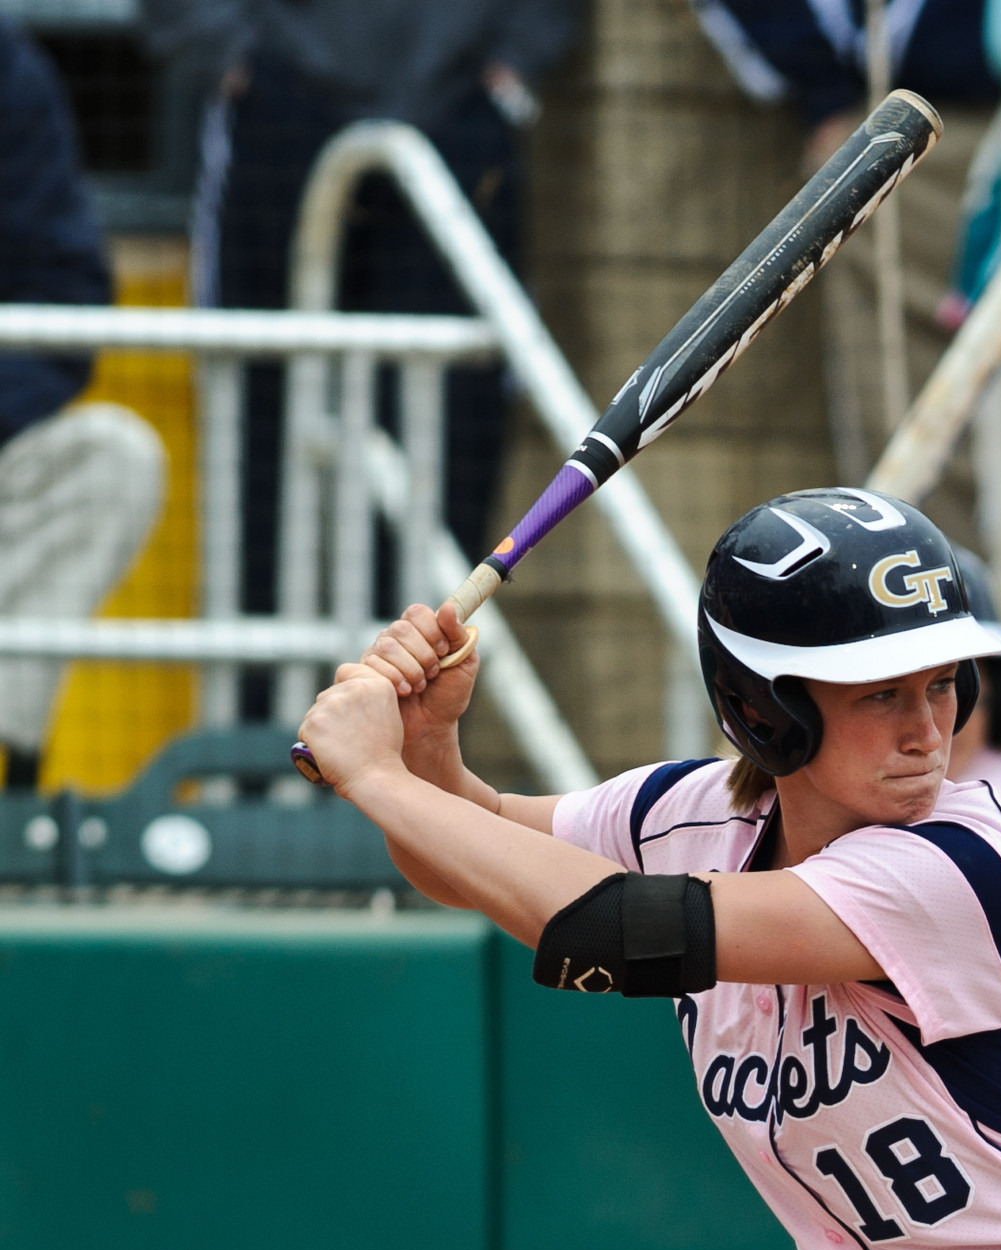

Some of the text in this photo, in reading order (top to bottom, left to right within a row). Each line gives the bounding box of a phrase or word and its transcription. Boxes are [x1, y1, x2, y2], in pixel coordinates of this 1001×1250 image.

[868, 549, 953, 613] GT
[676, 995, 891, 1126] acets
[812, 1113, 975, 1243] 18
